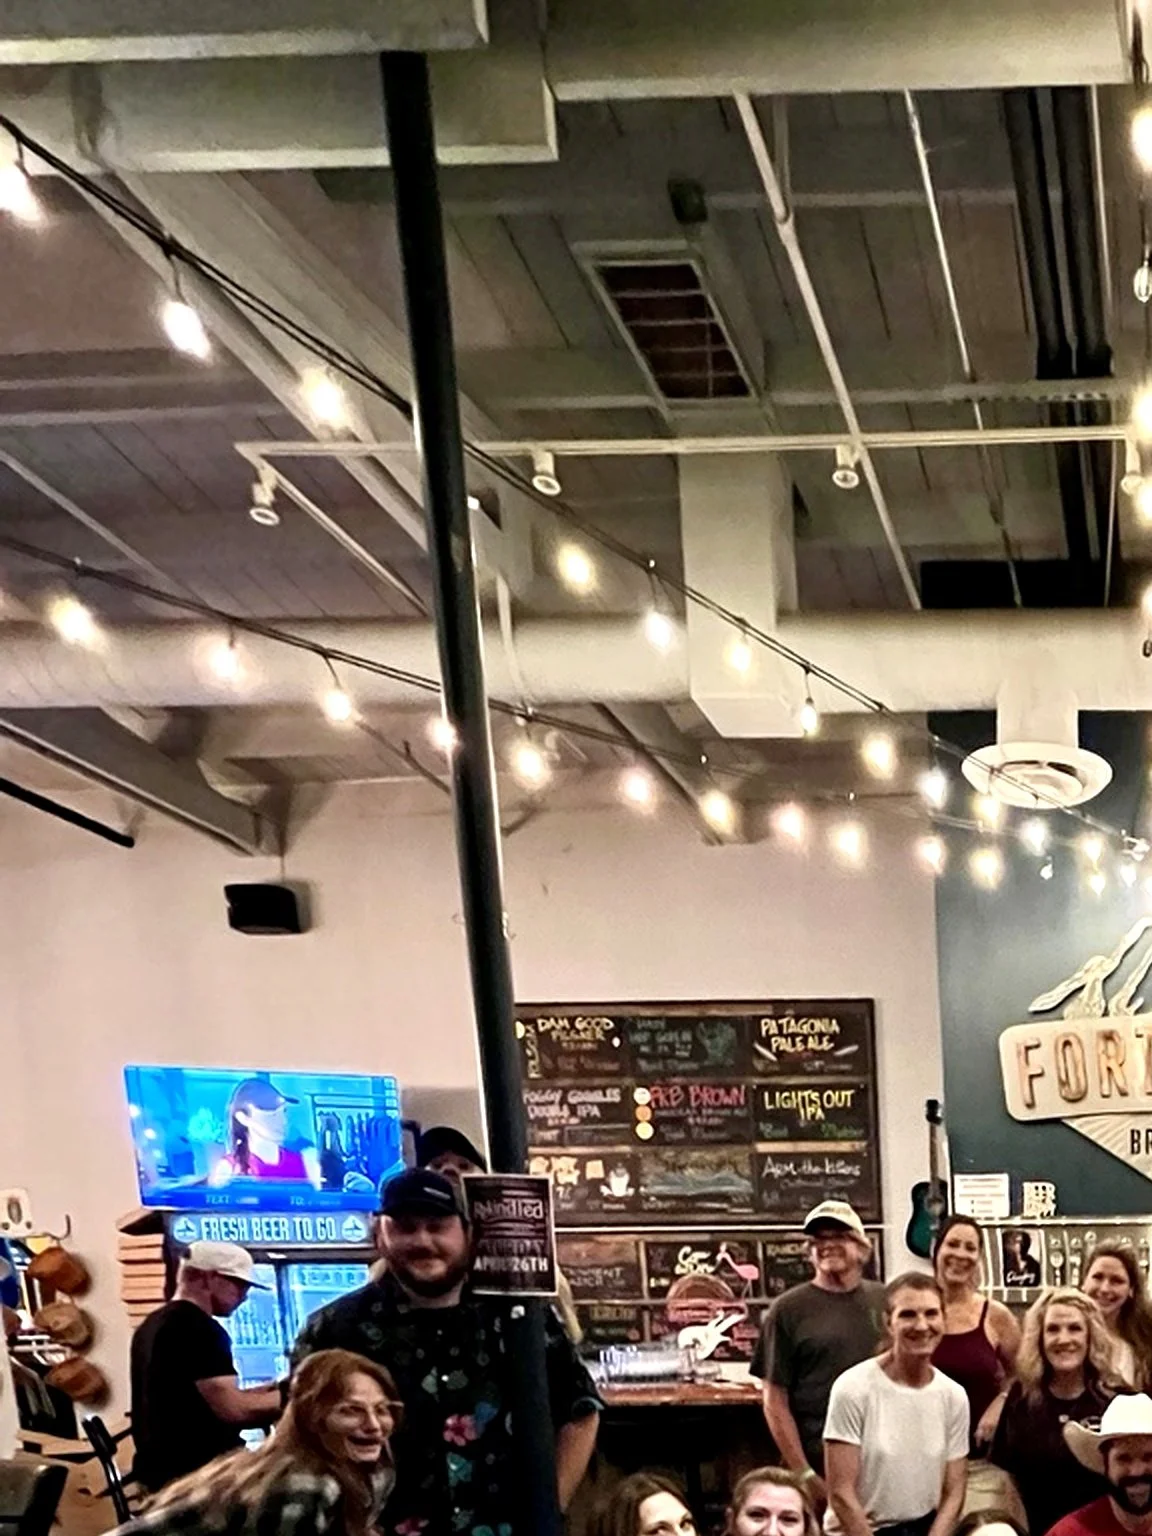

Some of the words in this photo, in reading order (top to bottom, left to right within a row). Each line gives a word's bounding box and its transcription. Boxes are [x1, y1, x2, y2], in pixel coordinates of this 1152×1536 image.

[536, 1017, 570, 1032] DAM
[575, 1017, 615, 1031] GOOD
[760, 1016, 840, 1037] PATAGONIA
[771, 1036, 805, 1053] PALE
[807, 1035, 835, 1051] ALE
[764, 1089, 821, 1110] LIGHTS
[823, 1089, 855, 1108] OUT
[799, 1107, 826, 1120] IPA
[201, 1216, 249, 1241] FRESH
[252, 1216, 290, 1241] BEER
[293, 1217, 313, 1240] TO
[317, 1217, 336, 1240] GO
[512, 1256, 549, 1272] 26TH
